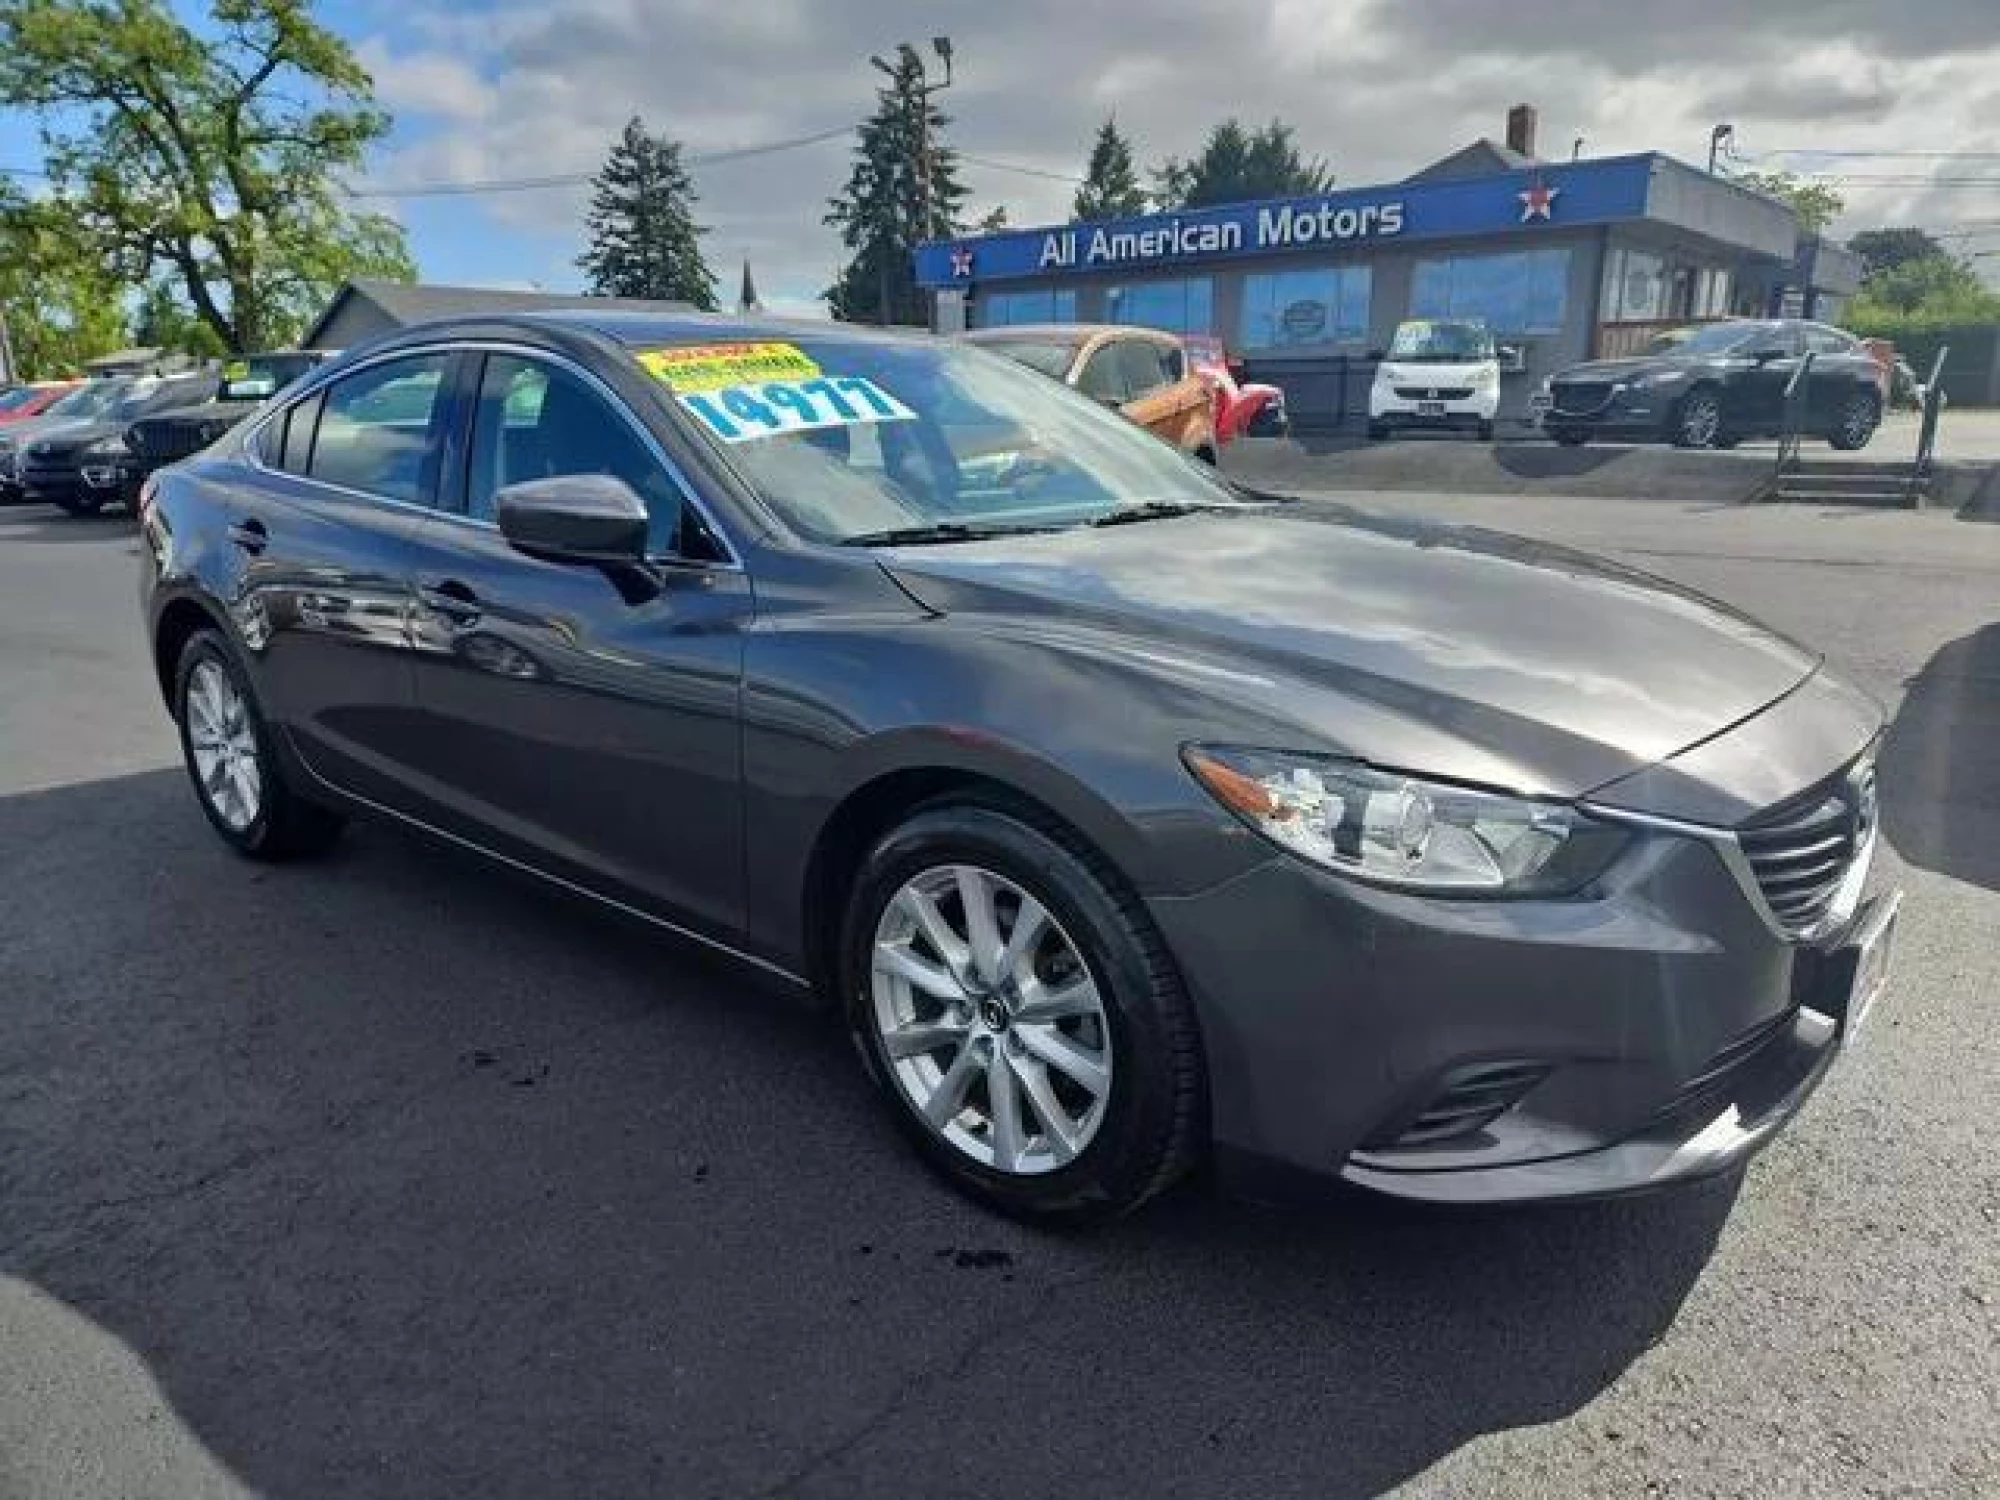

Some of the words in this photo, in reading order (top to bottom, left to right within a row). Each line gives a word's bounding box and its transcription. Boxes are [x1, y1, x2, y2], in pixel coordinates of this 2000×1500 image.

[1039, 230, 1076, 267] All
[1087, 218, 1241, 263] American
[1258, 202, 1404, 245] Motors
